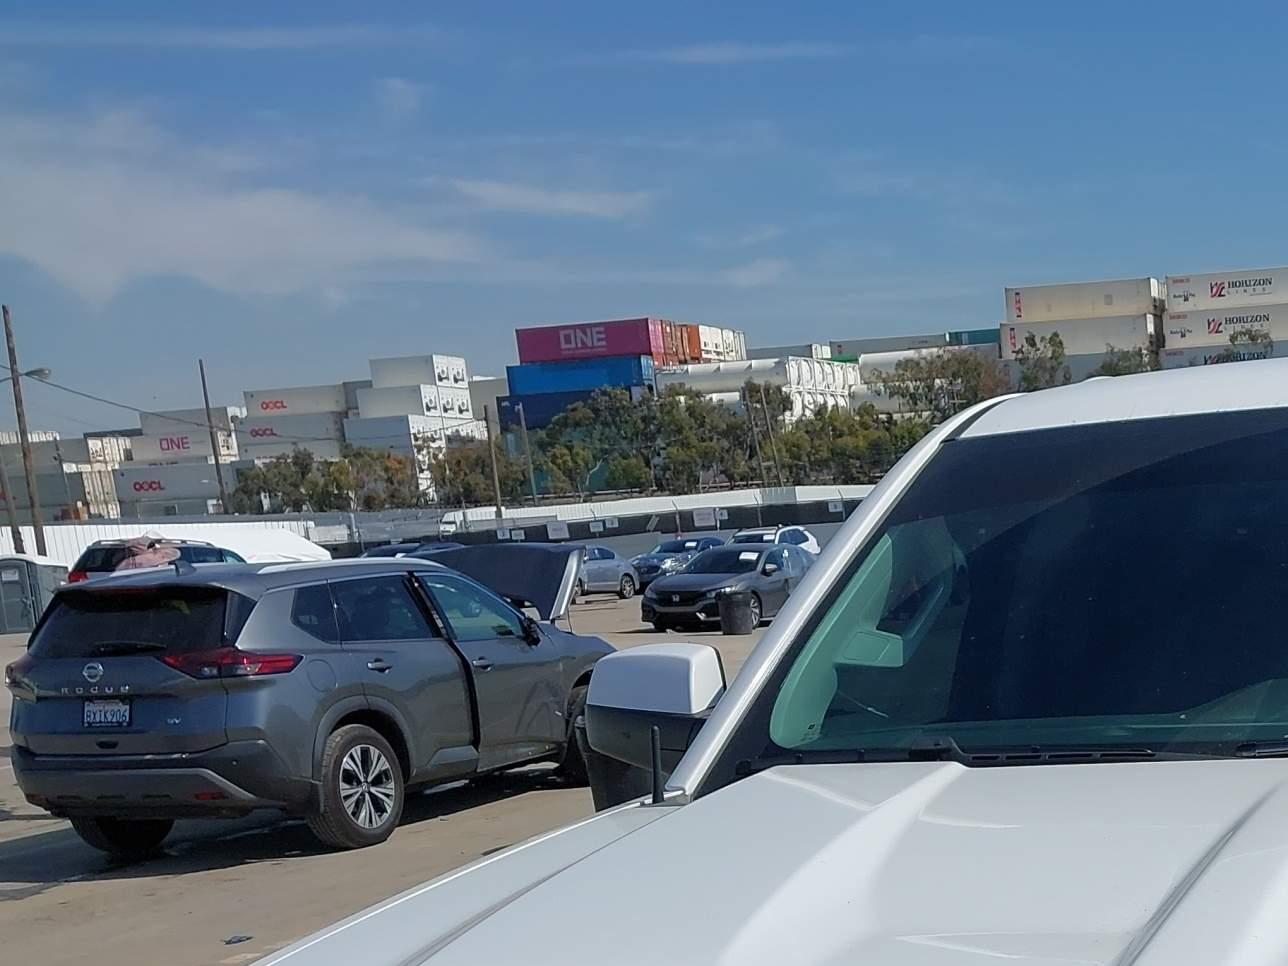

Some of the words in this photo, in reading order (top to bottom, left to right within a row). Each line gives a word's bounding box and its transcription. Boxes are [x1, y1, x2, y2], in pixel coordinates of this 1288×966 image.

[1228, 277, 1272, 288] HORIZON
[1224, 313, 1270, 325] HORIZON
[560, 327, 607, 350] ONE
[260, 400, 288, 410] OOCL
[250, 428, 278, 438] OOCL
[159, 436, 191, 451] ONE
[133, 480, 166, 492] OOCL
